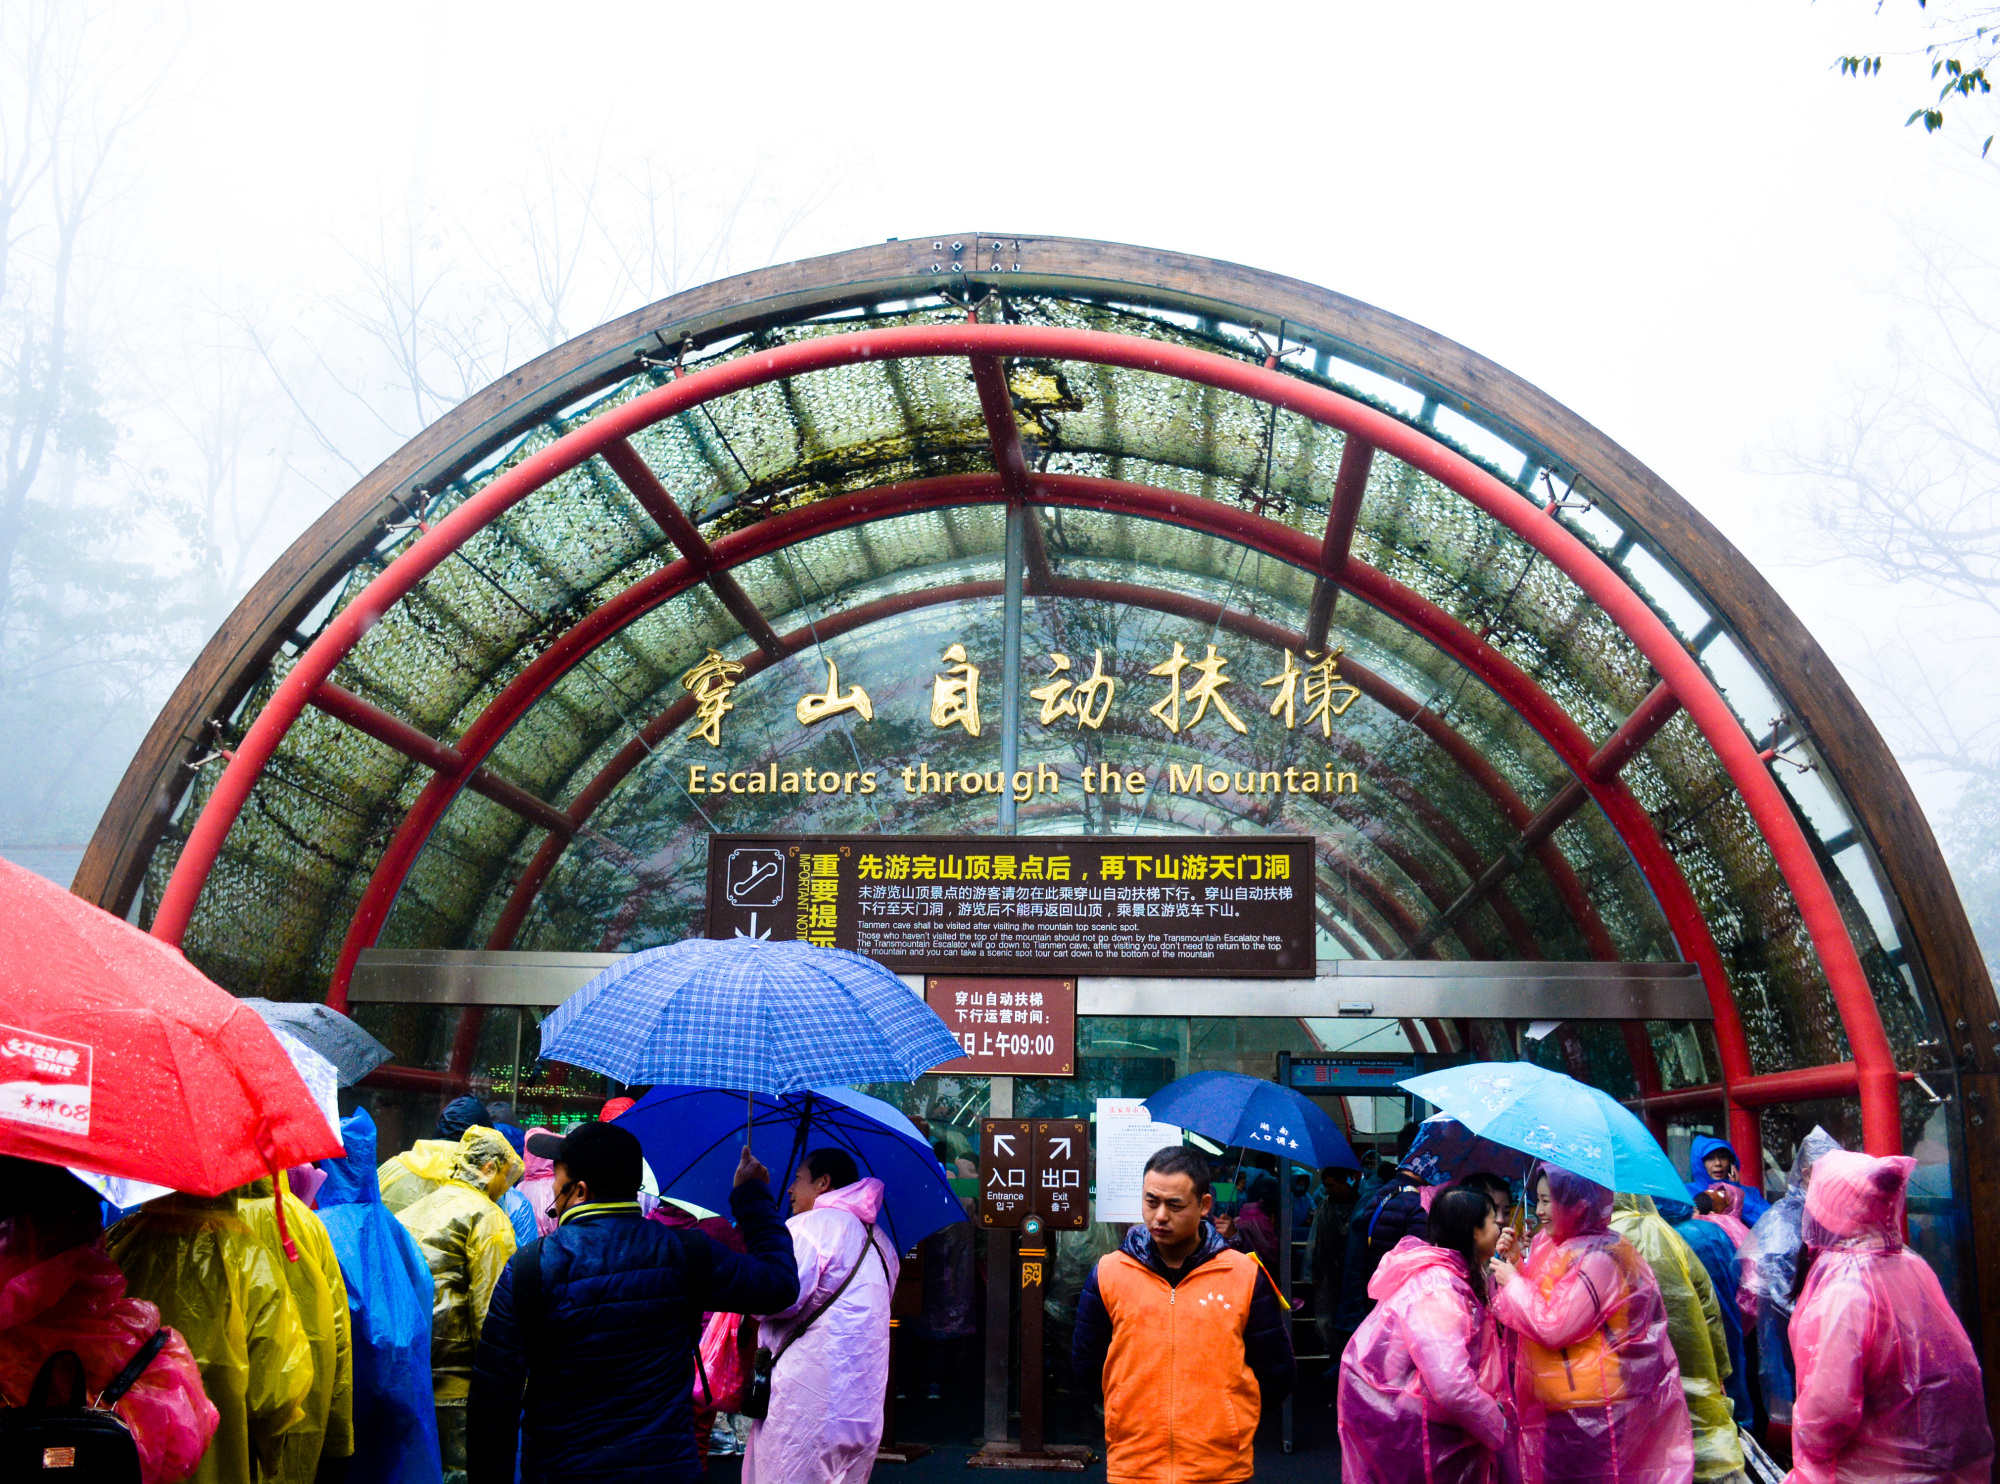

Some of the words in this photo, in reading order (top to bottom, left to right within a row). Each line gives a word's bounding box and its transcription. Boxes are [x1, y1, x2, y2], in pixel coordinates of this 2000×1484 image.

[682, 641, 1360, 746] 穿山自动扶梯
[688, 762, 877, 794] Escalators
[901, 762, 1060, 801] through
[1081, 762, 1146, 794] the
[1169, 762, 1359, 795] Mountain
[797, 853, 811, 912] IMPORTANT
[809, 854, 840, 948] 重要提示
[858, 921, 889, 929] Tianmen
[914, 921, 930, 929] shall
[934, 921, 943, 929] be
[993, 922, 1019, 931] visiting
[1023, 922, 1034, 930] the
[1038, 922, 1073, 930] mountain
[1076, 922, 1088, 932] top
[1092, 922, 1117, 930] scenic
[1120, 923, 1139, 932] spot.
[857, 932, 880, 940] Those
[884, 932, 899, 940] who
[903, 932, 929, 940] haven't
[933, 932, 956, 940] visited
[960, 932, 971, 940] the
[975, 933, 987, 942] top
[1016, 933, 1051, 941] mountain
[1055, 933, 1079, 941] should
[1083, 933, 1095, 941] not
[1098, 935, 1108, 943] go
[1112, 933, 1132, 941] down
[1136, 933, 1145, 943] by
[1224, 934, 1260, 942] Escalator
[1263, 934, 1282, 942] here.
[857, 940, 871, 948] The
[874, 940, 929, 948] Transmountain
[933, 940, 968, 948] Escalator
[986, 942, 995, 950] go
[1023, 941, 1030, 949] to
[1034, 941, 1066, 949] Tianmen
[1069, 943, 1089, 951] cave,
[1093, 941, 1110, 949] after
[1114, 942, 1140, 951] visiting
[1143, 943, 1157, 951] you
[1183, 942, 1202, 950] need
[1206, 942, 1213, 950] to
[1217, 942, 1239, 950] return
[1242, 942, 1250, 950] to
[1253, 942, 1265, 950] the
[1268, 942, 1281, 952] top
[872, 948, 906, 956] mountain
[910, 948, 924, 956] and
[927, 950, 940, 958] you
[987, 949, 1012, 957] scenic
[1016, 949, 1032, 959] spot
[1036, 949, 1050, 957] tour
[1054, 949, 1068, 957] cart
[1121, 950, 1148, 958] bottom
[1152, 950, 1159, 958] of
[1163, 950, 1175, 958] the
[1178, 950, 1214, 958] mountain
[955, 991, 1044, 1007] 穿山自动扶梯
[955, 1008, 1050, 1024] 下行运营时间：
[34, 1059, 77, 1077] DHS
[987, 1167, 1025, 1188] 入口
[1041, 1167, 1080, 1188] 出口
[987, 1191, 1024, 1201] Entrance
[1052, 1192, 1068, 1201] Exit
[996, 1201, 1015, 1211] 입구
